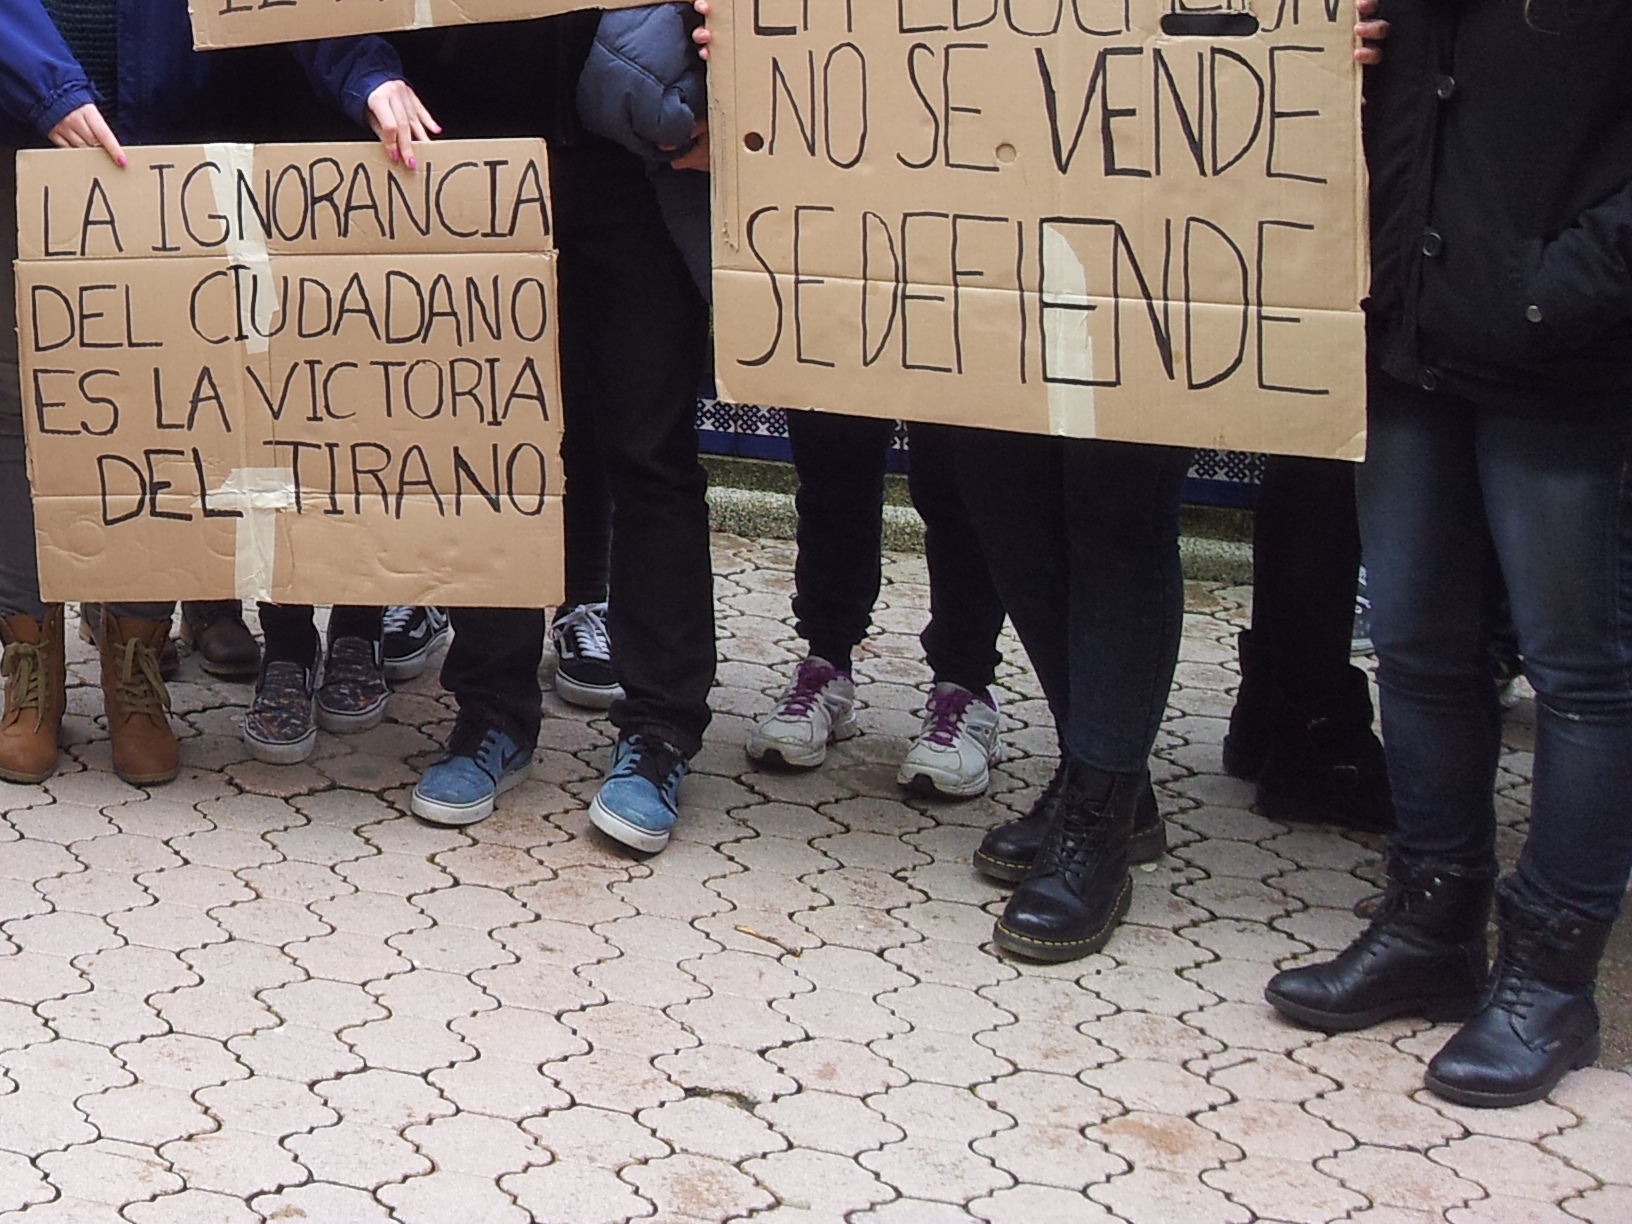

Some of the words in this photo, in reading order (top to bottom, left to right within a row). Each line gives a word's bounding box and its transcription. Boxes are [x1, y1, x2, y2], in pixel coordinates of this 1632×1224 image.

[769, 42, 868, 169] NO
[897, 42, 1000, 172] SE
[1035, 45, 1329, 184] VENDE
[43, 176, 124, 257] LA
[149, 156, 551, 252] IGNORANCIA
[31, 283, 163, 352] DEL
[190, 265, 548, 347] CIUDADANO
[32, 368, 120, 437] ES
[154, 366, 232, 432] LA
[246, 357, 549, 427] VICTORIA
[96, 446, 244, 526] DEL
[262, 440, 546, 520] TIRANO
